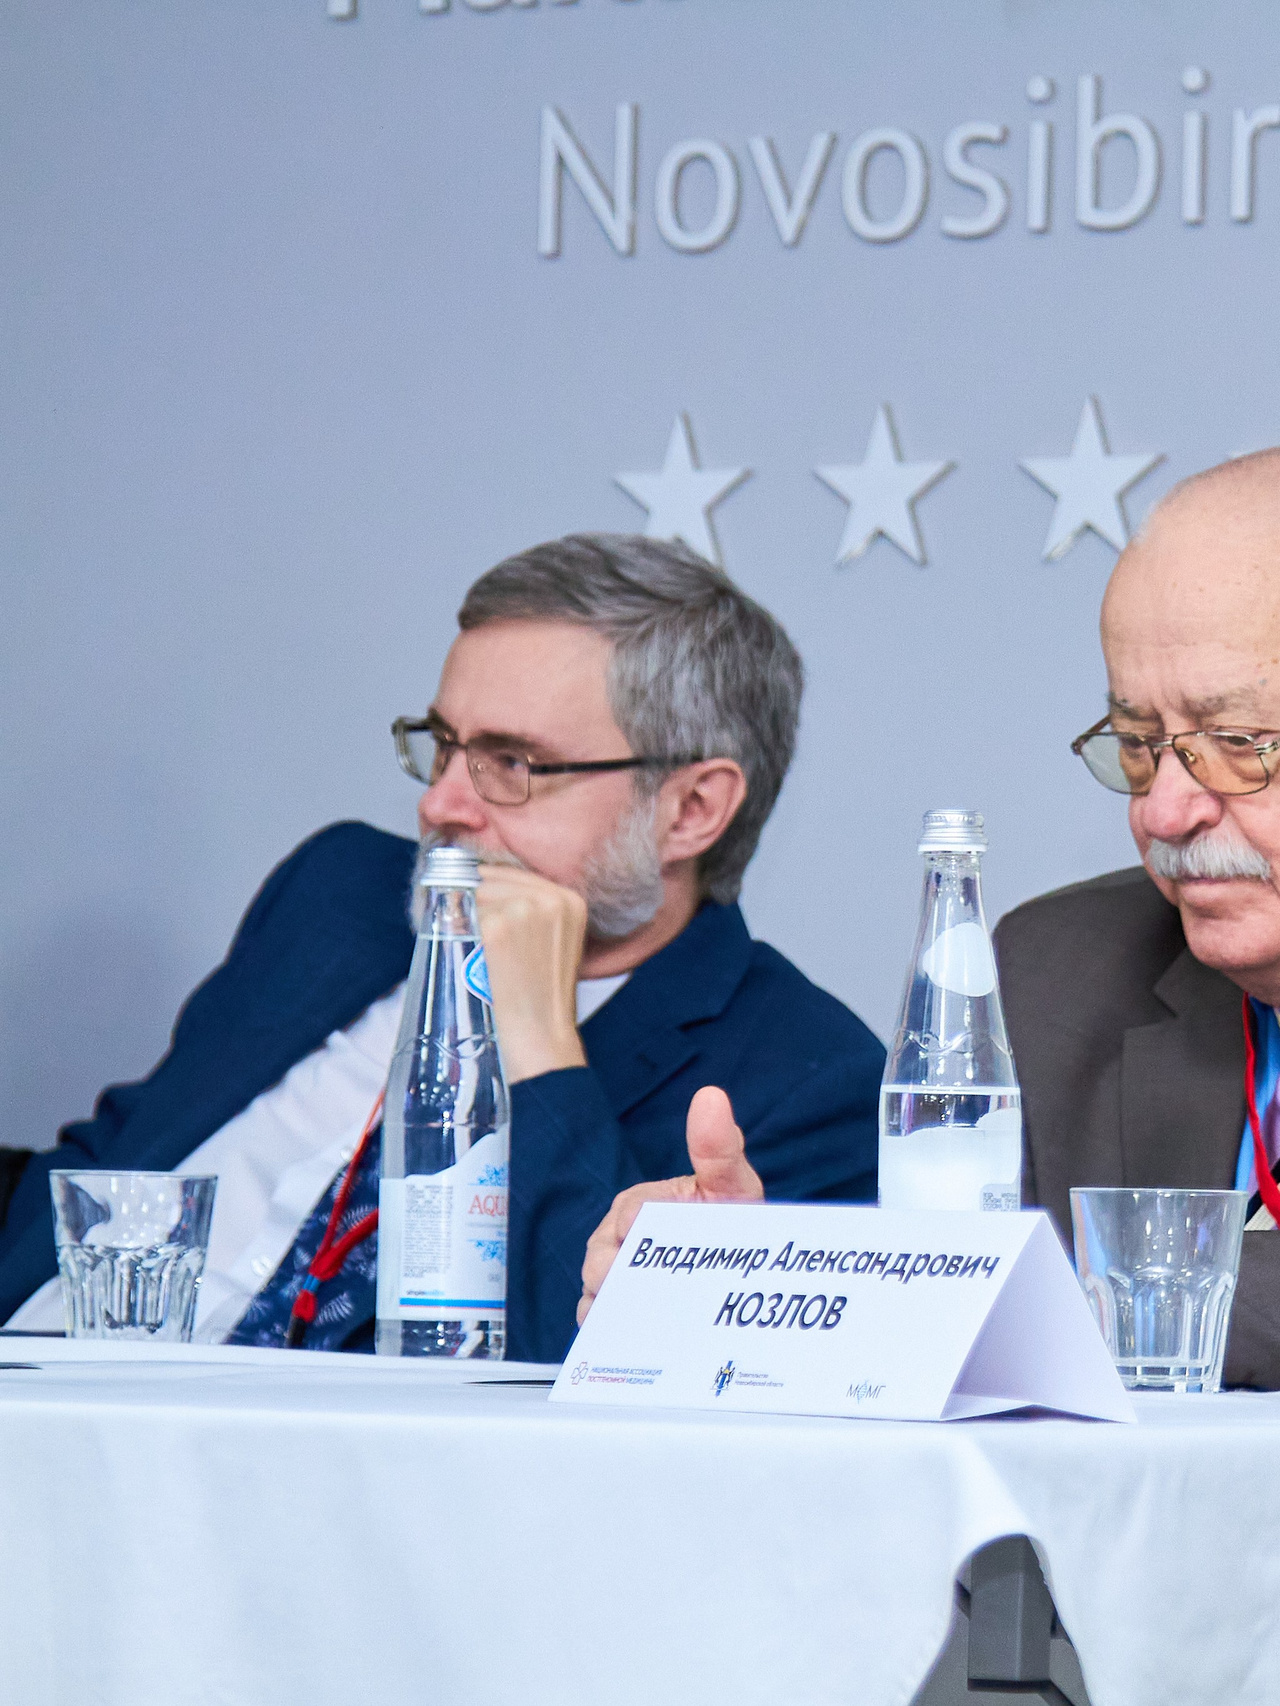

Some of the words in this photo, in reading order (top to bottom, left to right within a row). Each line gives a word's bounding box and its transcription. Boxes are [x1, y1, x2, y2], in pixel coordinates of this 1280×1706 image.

[628, 1238, 769, 1278] Владимир
[767, 1241, 1001, 1284] Александрович
[713, 1291, 848, 1331] КОЗЛОВ
